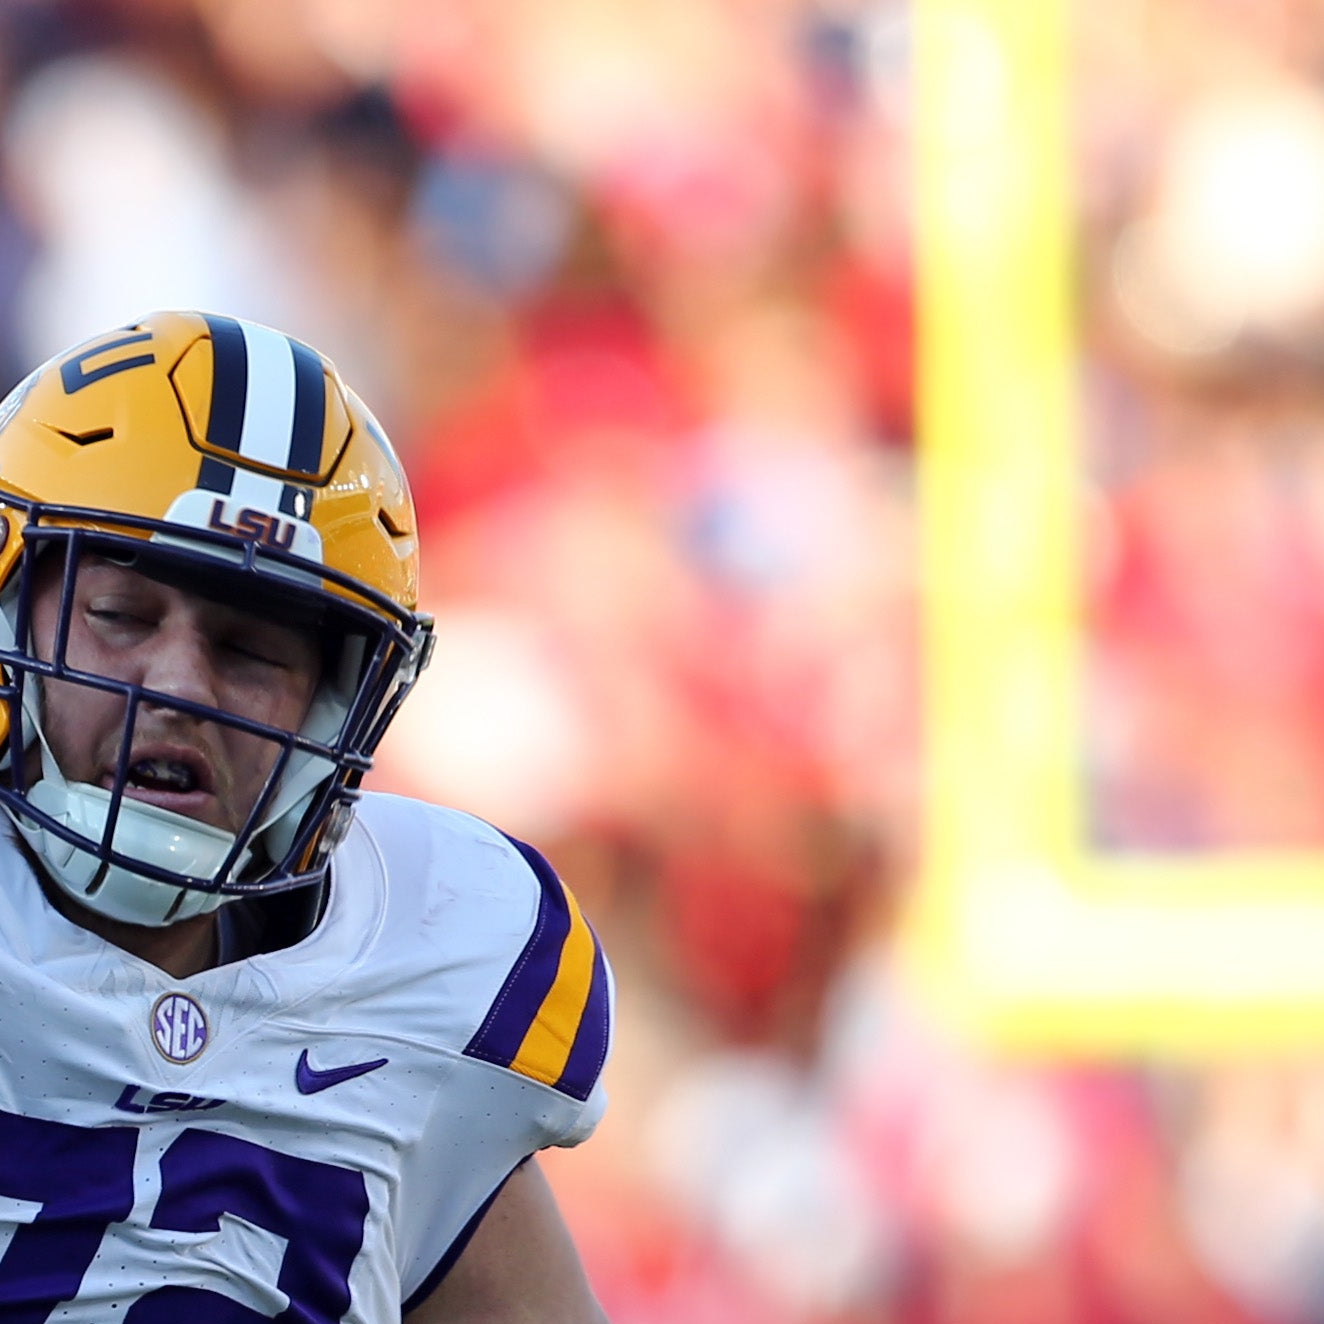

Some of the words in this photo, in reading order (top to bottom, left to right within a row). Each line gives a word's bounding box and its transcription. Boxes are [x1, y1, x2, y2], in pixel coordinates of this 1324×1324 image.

[207, 499, 297, 551] LSU
[154, 995, 205, 1060] SEC
[114, 1083, 228, 1114] LSU
